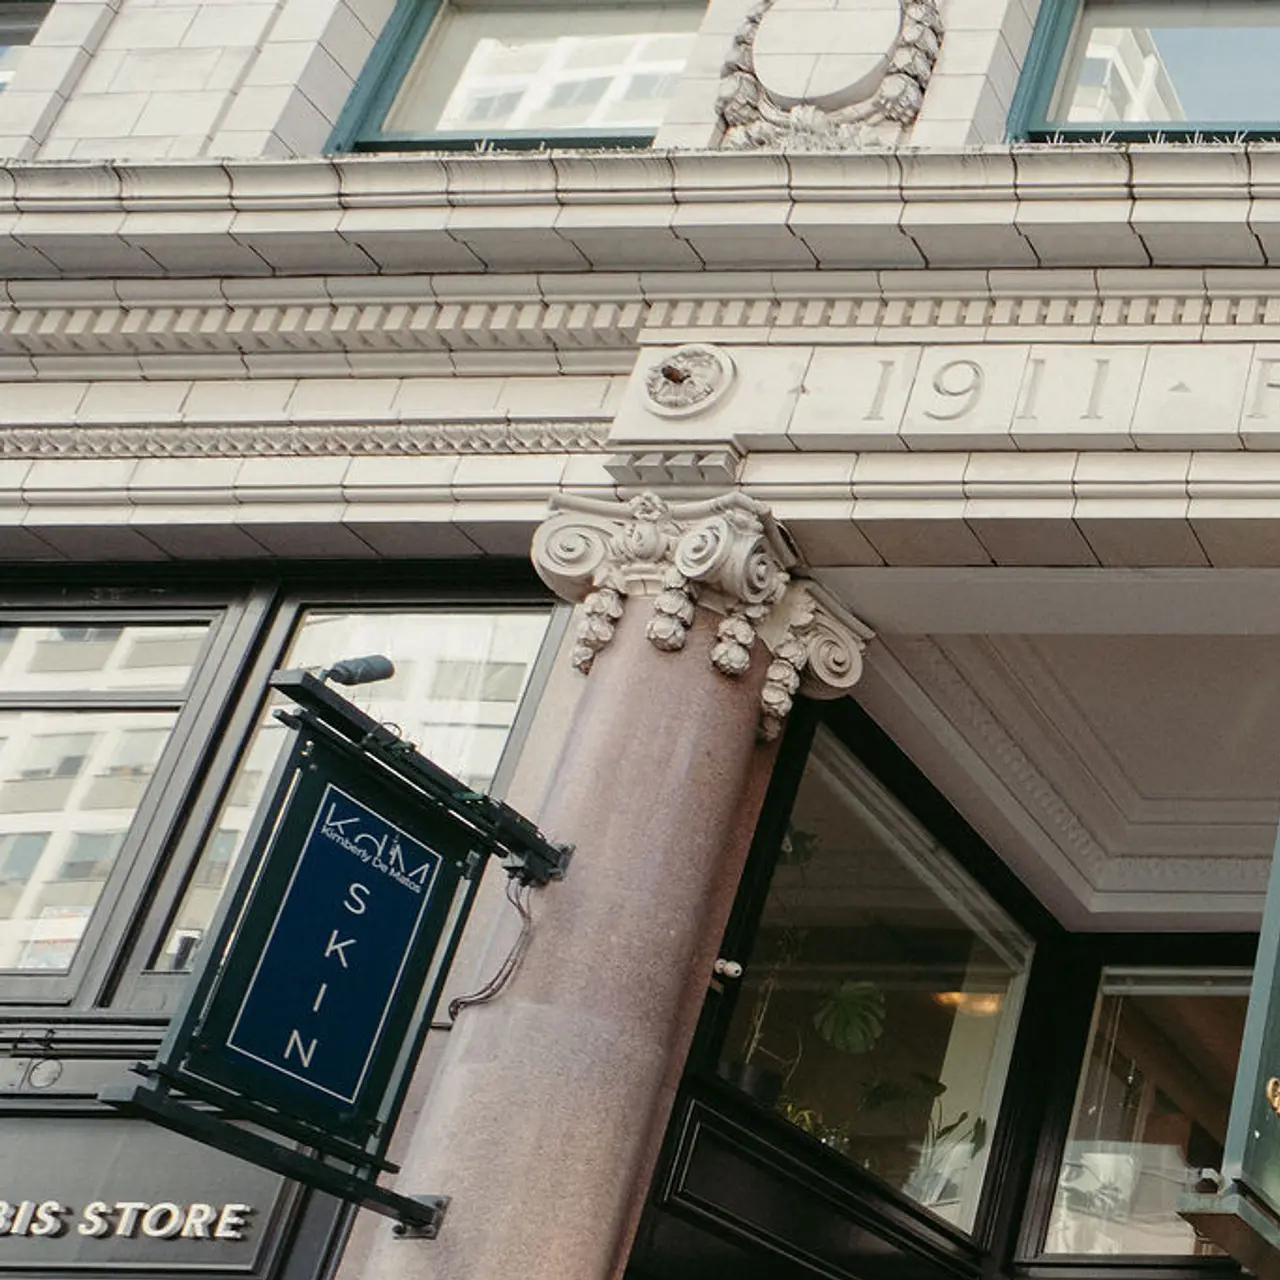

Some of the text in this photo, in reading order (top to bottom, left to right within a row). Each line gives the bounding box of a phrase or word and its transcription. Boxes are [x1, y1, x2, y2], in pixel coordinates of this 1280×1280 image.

[862, 357, 1113, 423] 1911
[320, 824, 422, 895] Kimberly De Matos
[78, 1201, 252, 1240] STORE
